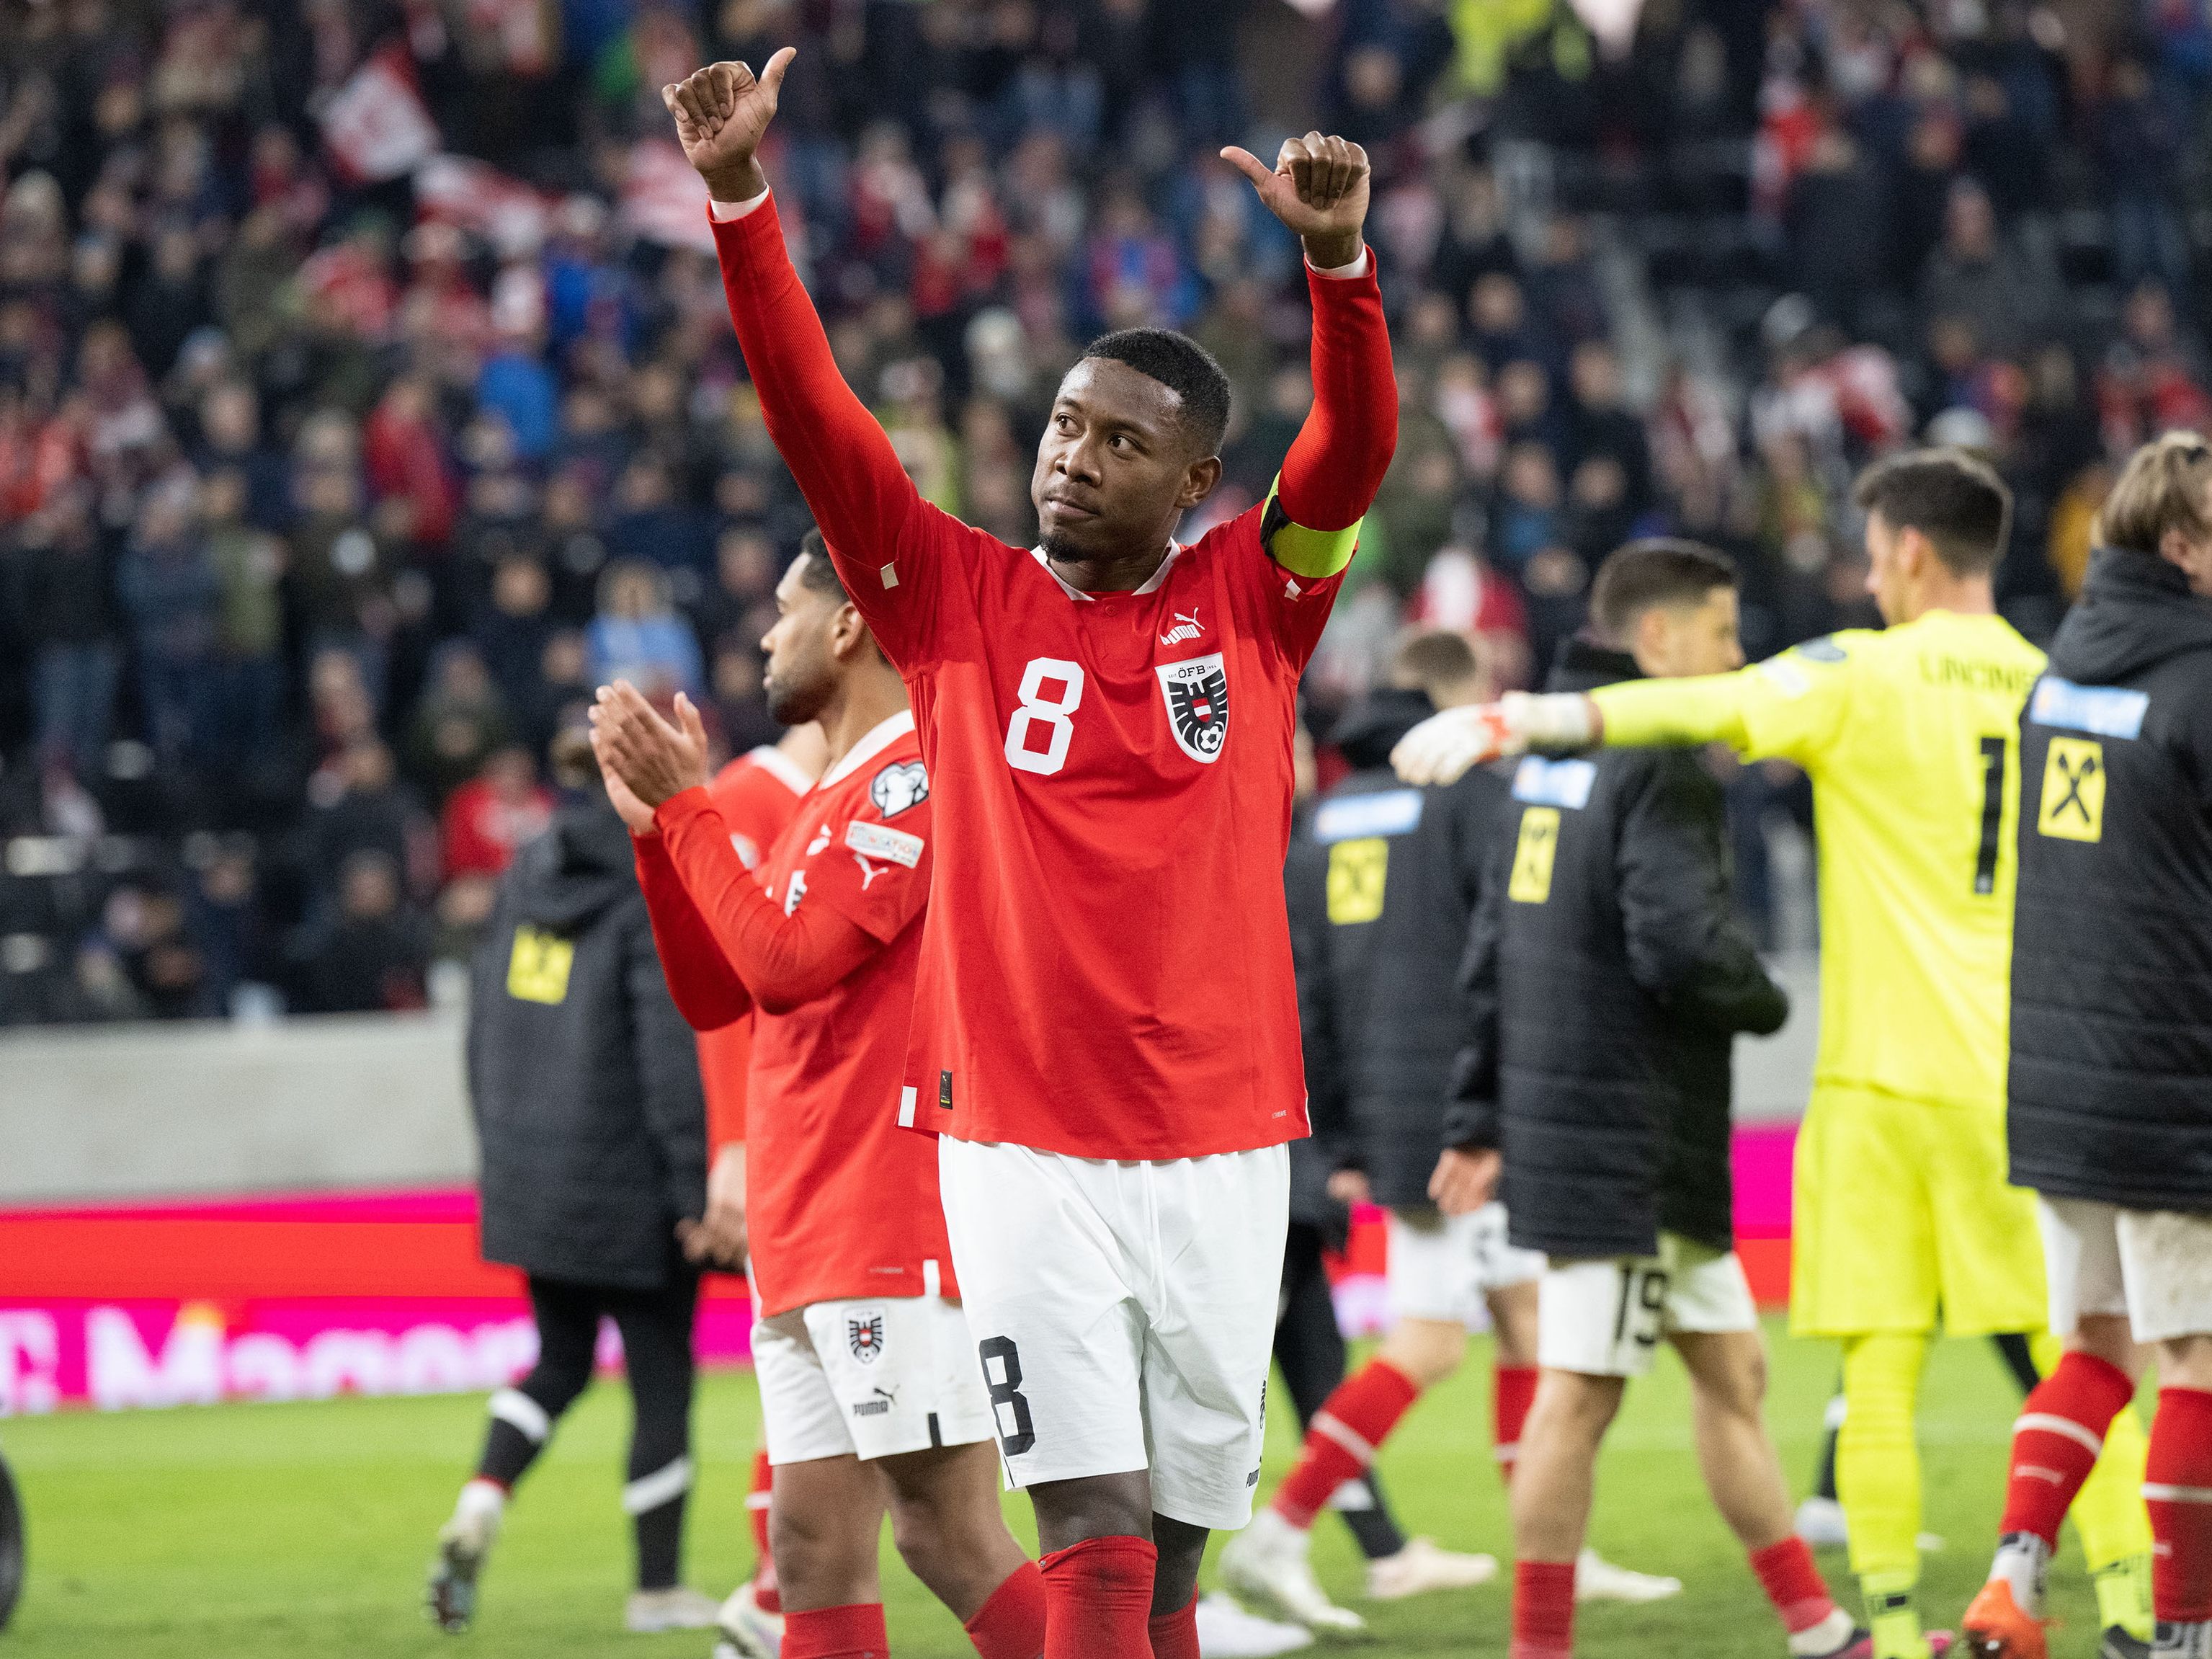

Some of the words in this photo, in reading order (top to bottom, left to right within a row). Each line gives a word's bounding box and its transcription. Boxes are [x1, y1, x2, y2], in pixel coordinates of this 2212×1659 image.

[1159, 624, 1202, 646] PUMA
[1178, 665, 1206, 679] ÖFB
[1004, 657, 1085, 776] 8
[1973, 737, 2006, 896] 1
[978, 1335, 1036, 1457] 8
